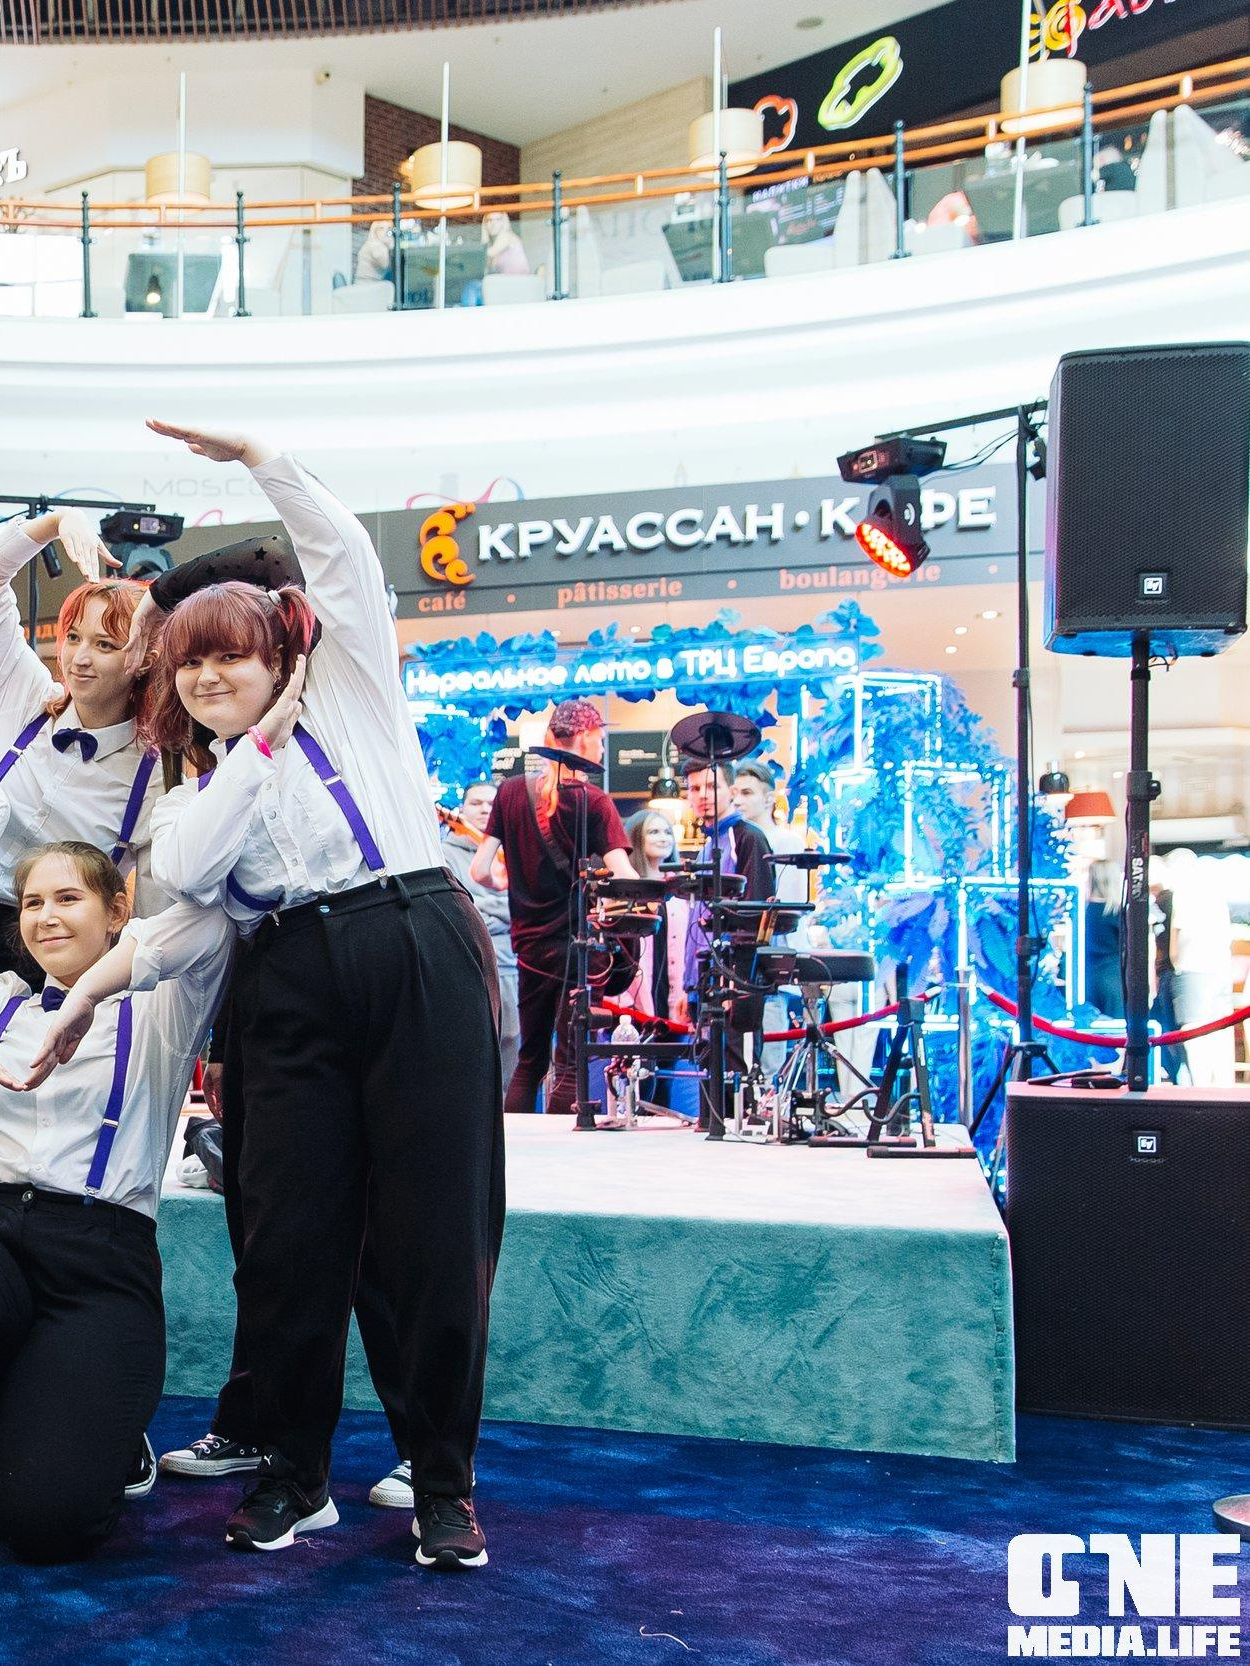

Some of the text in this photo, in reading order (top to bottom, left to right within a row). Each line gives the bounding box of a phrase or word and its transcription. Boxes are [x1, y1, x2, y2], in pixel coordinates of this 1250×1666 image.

[478, 486, 997, 561] КРУАССАН КФЕ
[558, 577, 683, 608] pâtisserie
[779, 565, 941, 590] boulangie
[418, 590, 466, 612] café
[406, 645, 856, 699] Нереальное лето в ТРЦ Европа
